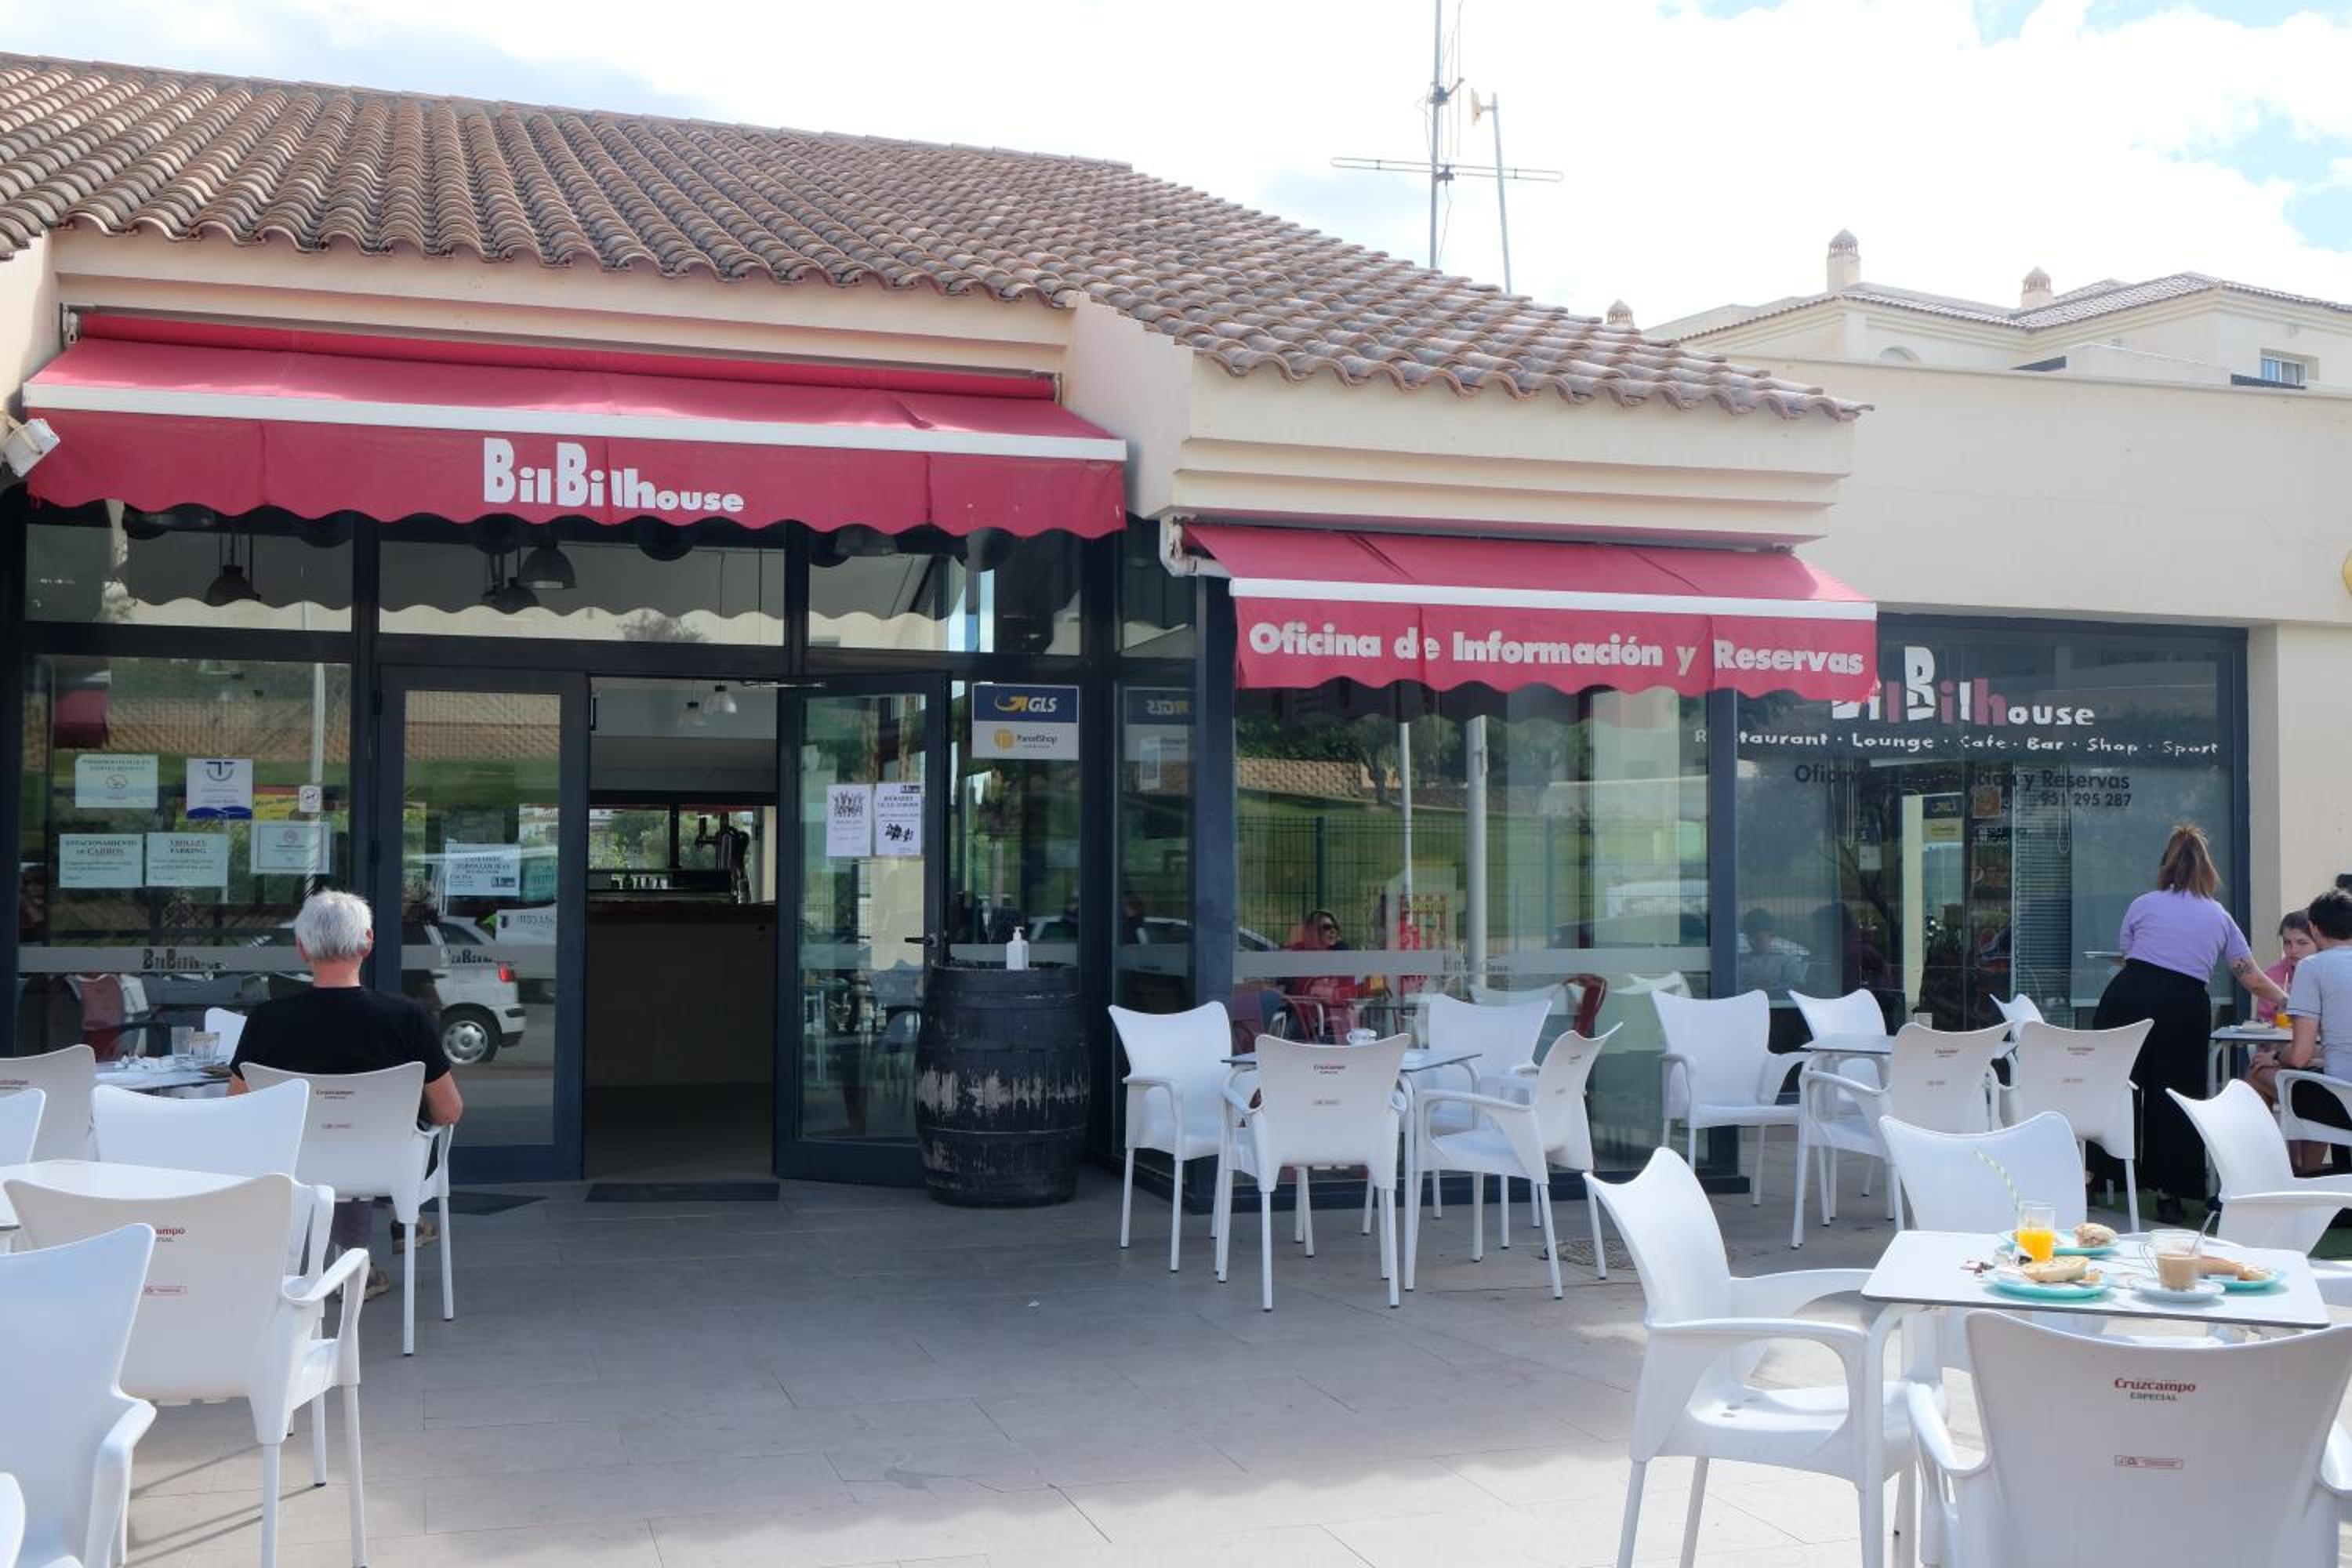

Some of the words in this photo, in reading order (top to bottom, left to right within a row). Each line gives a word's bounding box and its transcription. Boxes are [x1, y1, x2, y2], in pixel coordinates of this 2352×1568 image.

[1249, 622, 1381, 655] Oficina
[1393, 627, 1441, 660] de
[1453, 630, 1663, 666] Información
[1675, 644, 1697, 676] y
[1714, 639, 1865, 675] Reservas
[1028, 697, 1058, 713] GLS
[1695, 729, 1828, 746] Rtaurant
[1852, 732, 1934, 752] Lounge
[2027, 737, 2065, 751] Bar
[2086, 738, 2139, 756] Shop
[2161, 741, 2219, 757] Sport
[2041, 768, 2131, 790] Reservas
[2074, 793, 2100, 807] 295
[2105, 793, 2132, 808] 287
[2114, 1377, 2196, 1393] Cruzcampo
[2130, 1392, 2178, 1402] ESPECIAL
